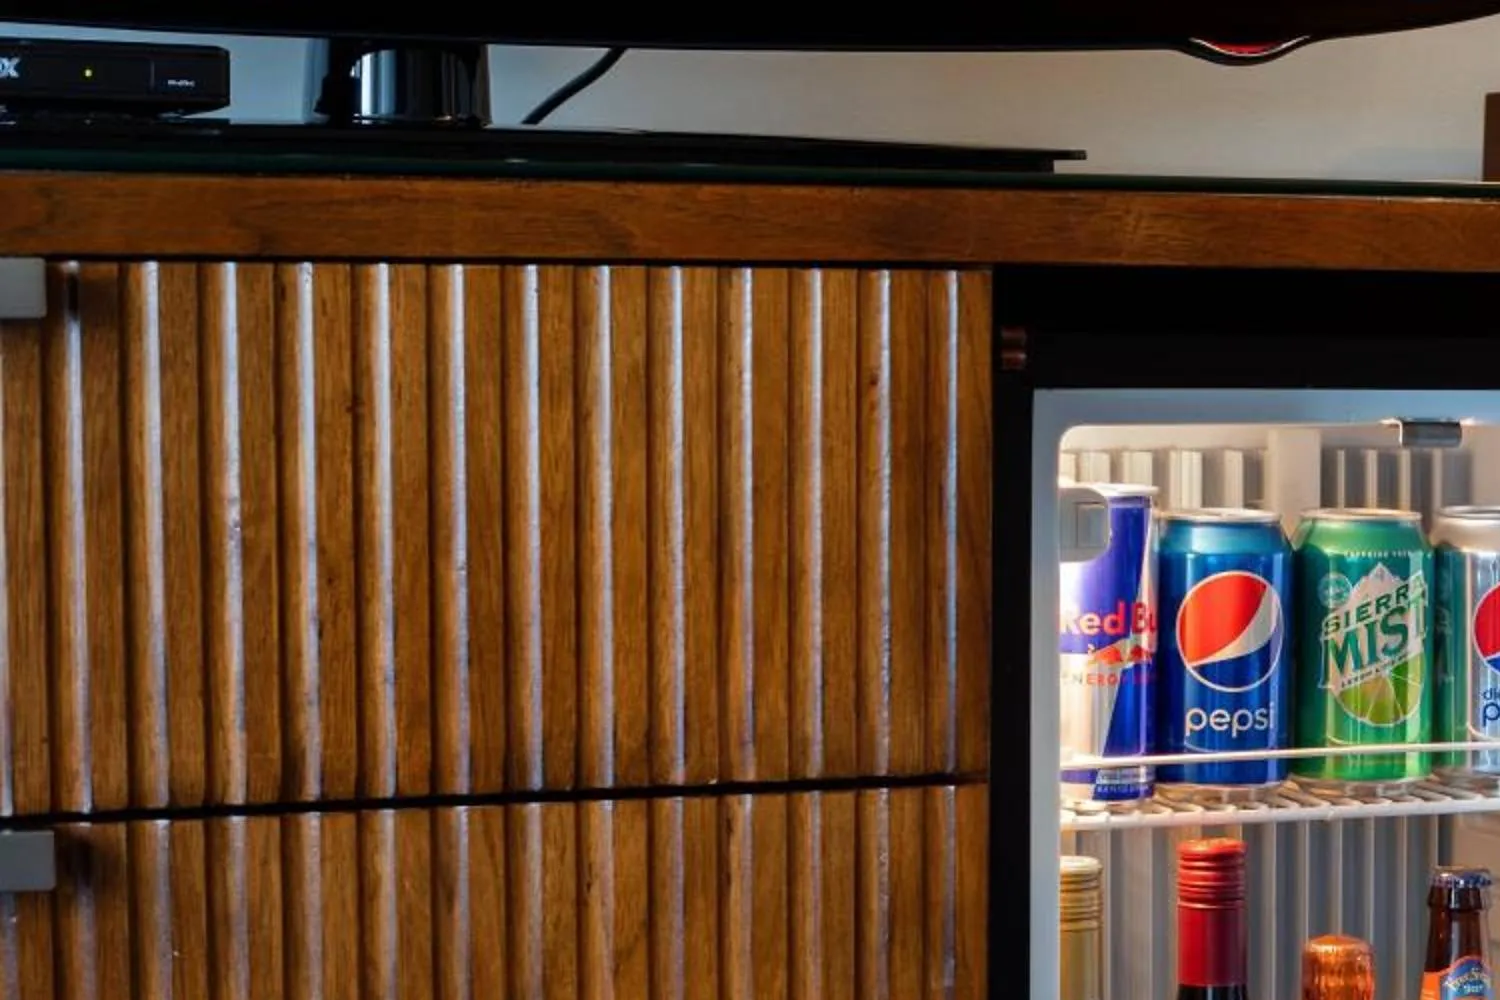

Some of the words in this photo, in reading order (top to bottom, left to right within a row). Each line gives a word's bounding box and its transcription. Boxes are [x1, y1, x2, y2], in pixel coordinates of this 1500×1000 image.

[1324, 574, 1427, 635] SIERRA
[1318, 594, 1427, 688] MIST
[1184, 701, 1275, 738] pepsi
